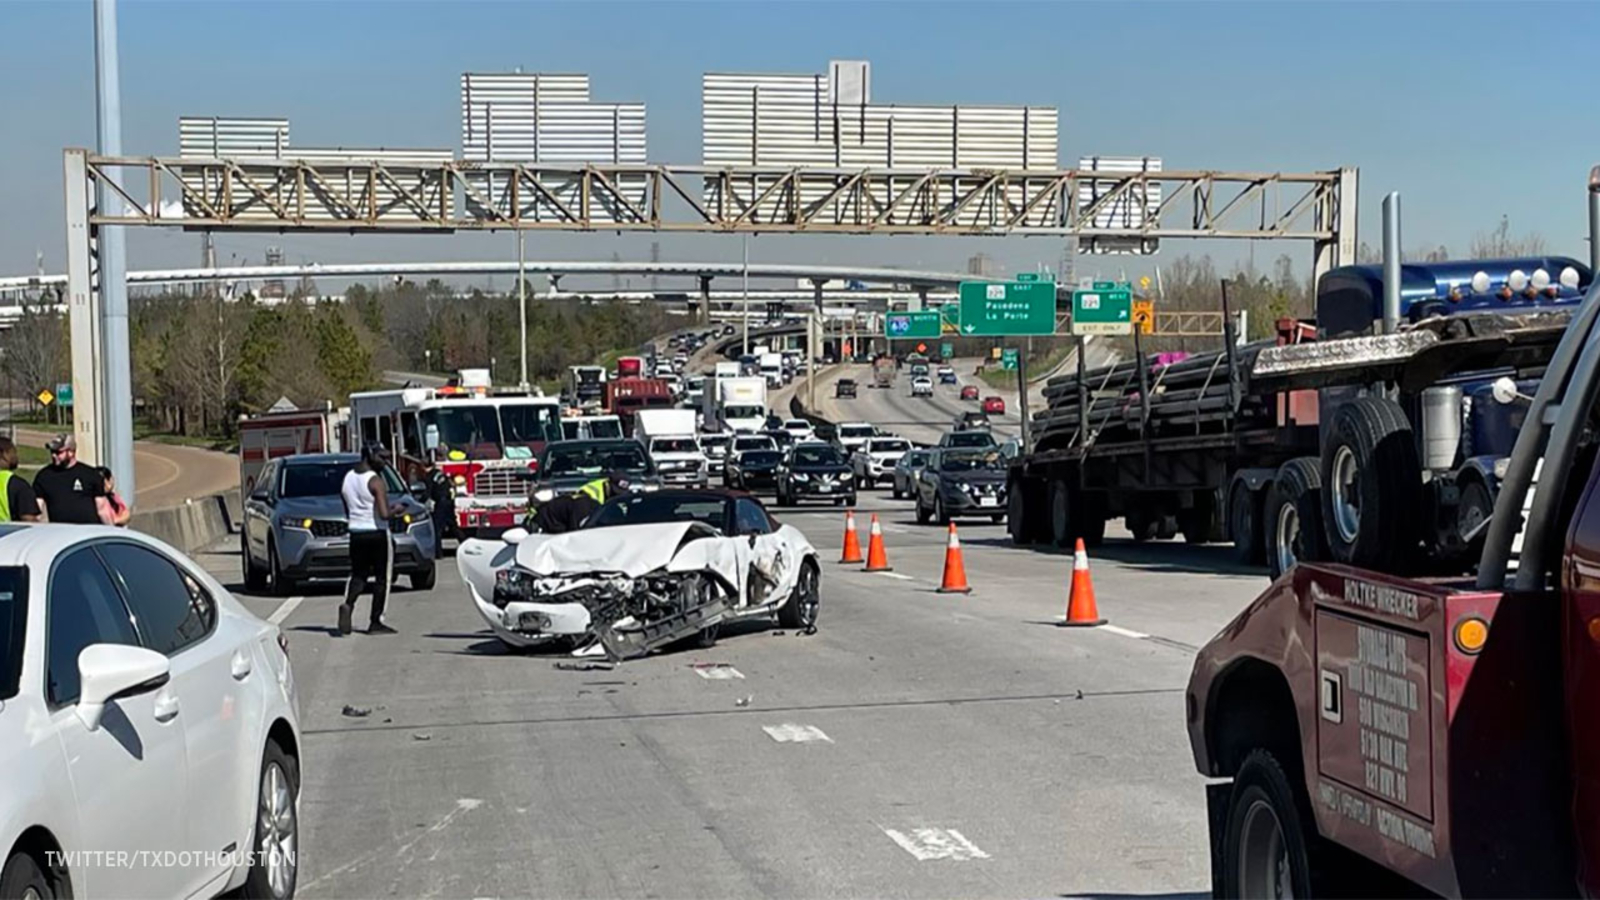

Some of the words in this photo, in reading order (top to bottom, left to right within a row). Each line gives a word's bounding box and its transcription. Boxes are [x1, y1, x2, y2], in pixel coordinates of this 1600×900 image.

[986, 301, 1030, 310] Pasadena
[986, 312, 997, 320] La
[1003, 312, 1029, 320] Porte
[1377, 587, 1419, 620] WRECKER
